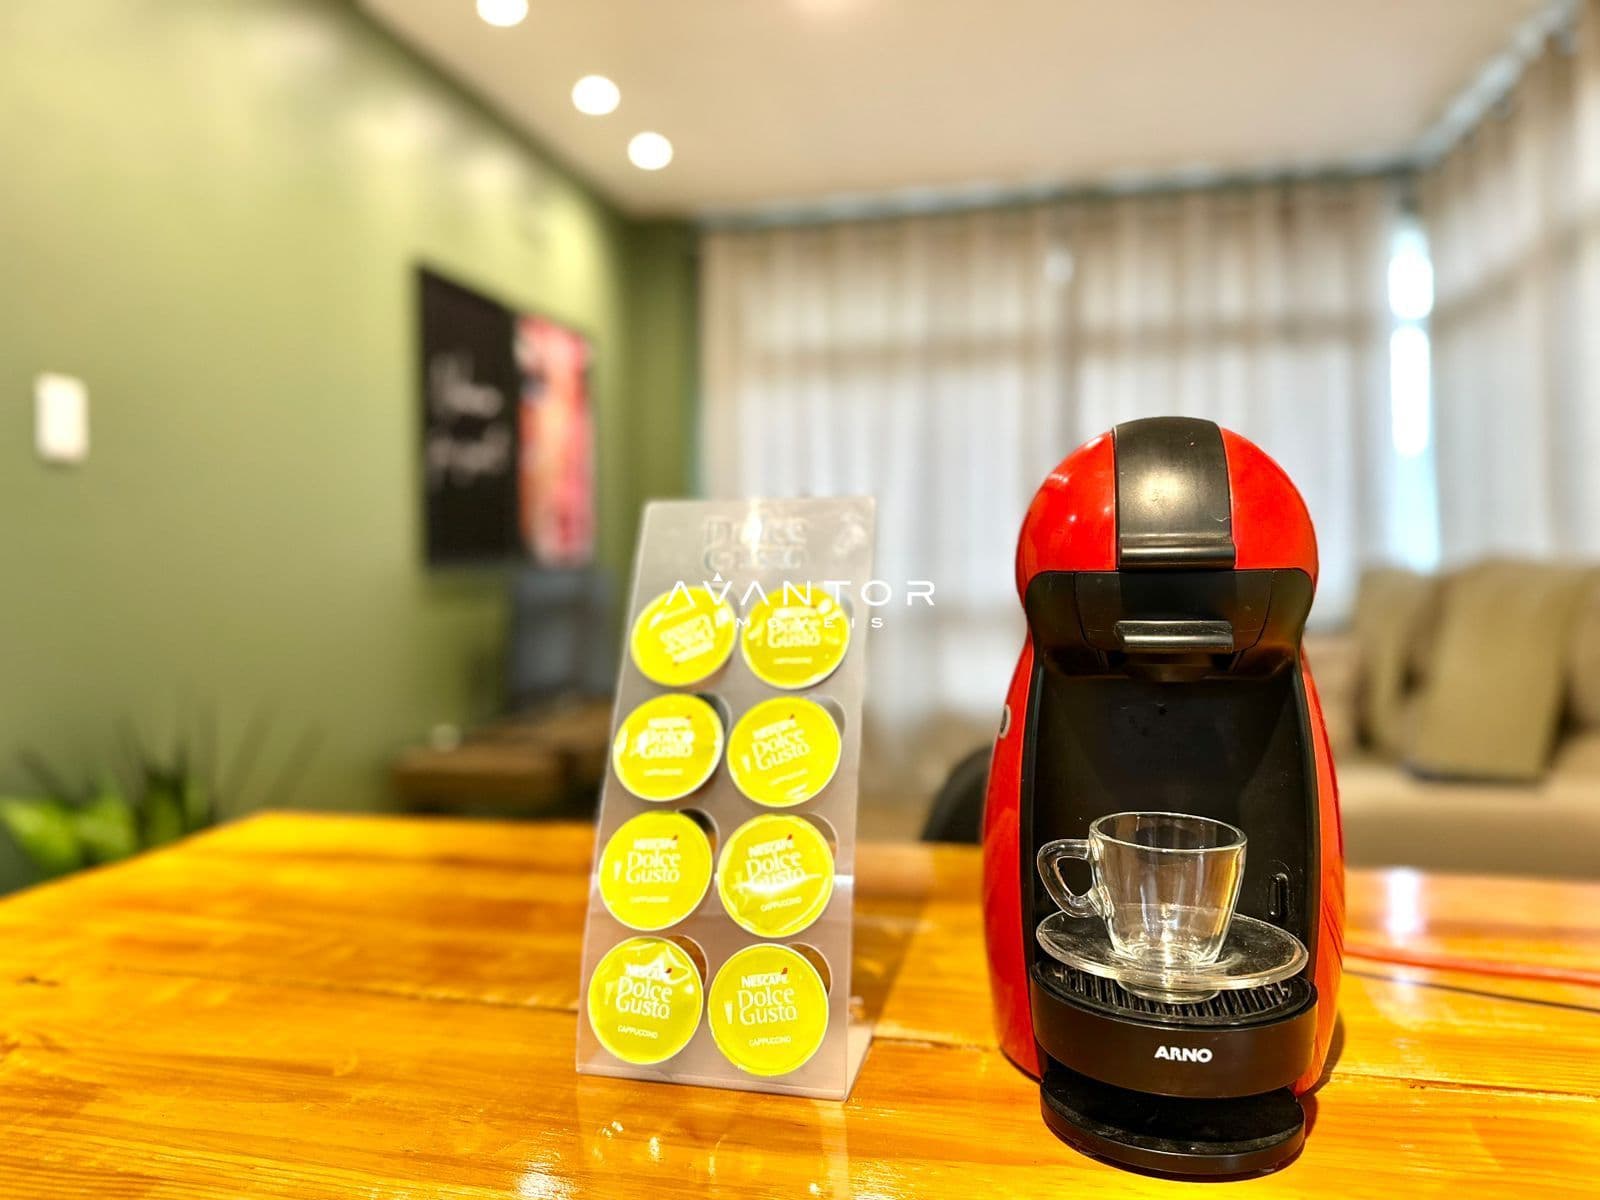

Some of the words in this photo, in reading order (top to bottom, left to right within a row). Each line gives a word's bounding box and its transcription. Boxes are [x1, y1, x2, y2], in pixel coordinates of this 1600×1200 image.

[627, 847, 682, 872] Dolce
[745, 850, 803, 880] Dolce
[625, 866, 681, 884] Gusto
[618, 976, 673, 1003] Dolce
[736, 985, 796, 1010] Dolce
[615, 992, 671, 1020] Gusto
[739, 1005, 798, 1026] Gusto
[1154, 1045, 1213, 1063] ARNO
